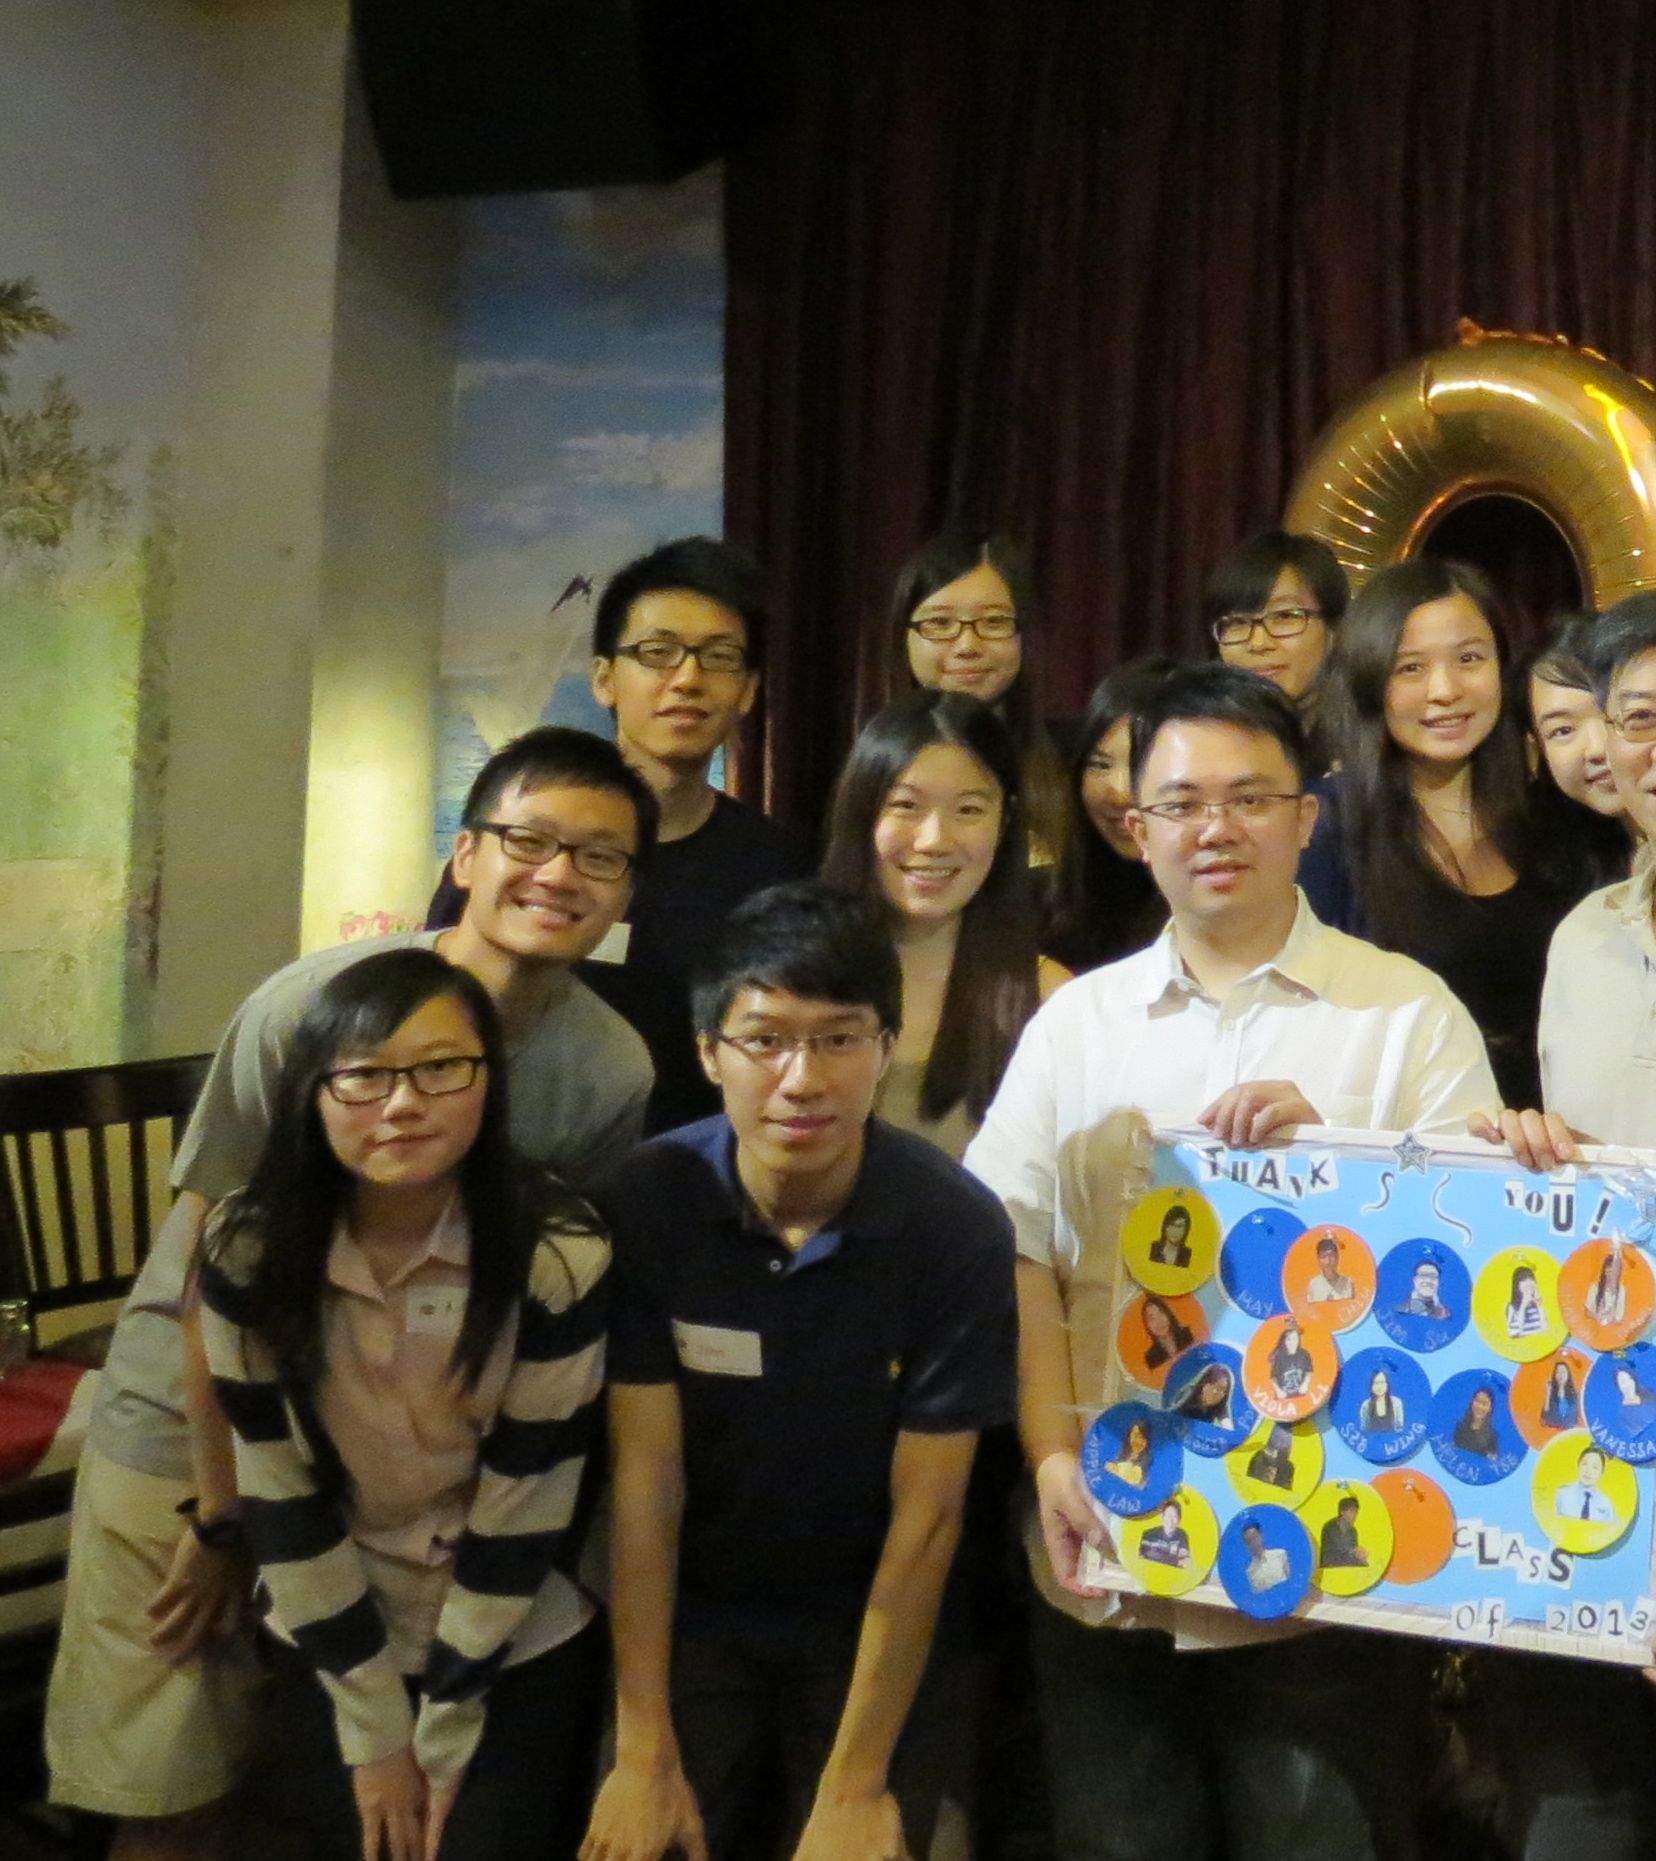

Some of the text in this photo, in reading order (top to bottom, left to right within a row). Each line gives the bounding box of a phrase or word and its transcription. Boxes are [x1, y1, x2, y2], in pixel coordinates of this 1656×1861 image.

[1253, 1386, 1297, 1416] VIOLA
[1453, 1526, 1574, 1583] CLASS
[1551, 1604, 1649, 1636] 2013
